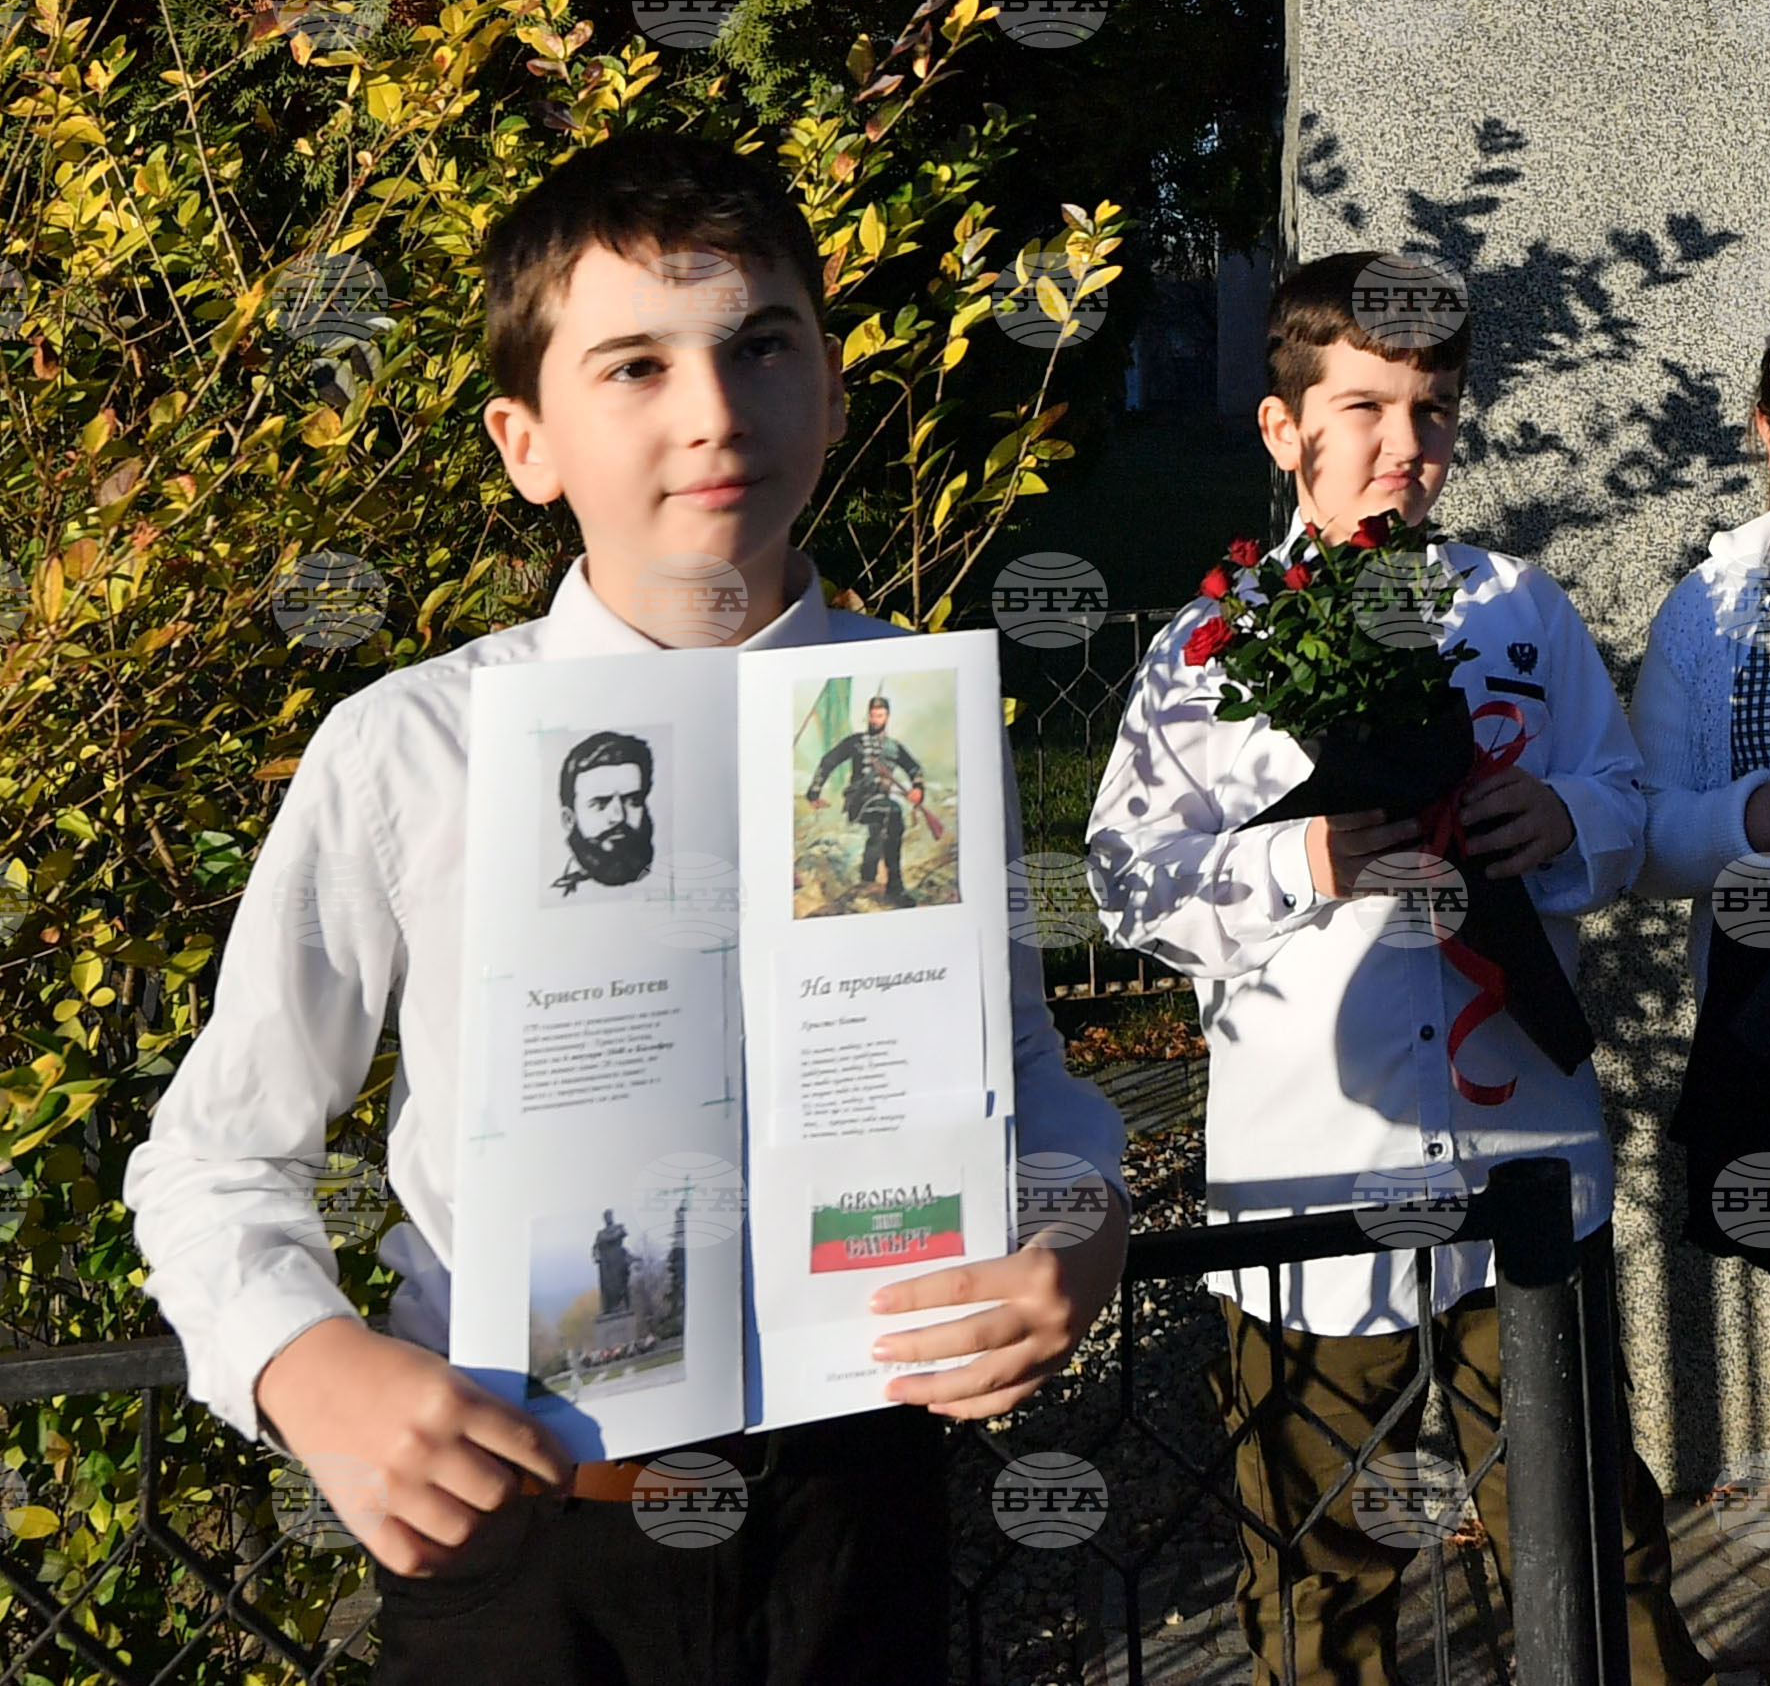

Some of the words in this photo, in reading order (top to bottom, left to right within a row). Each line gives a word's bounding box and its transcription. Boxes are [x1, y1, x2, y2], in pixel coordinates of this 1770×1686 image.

[526, 986, 604, 1010] Христо
[610, 978, 669, 998] Ботев
[800, 975, 832, 998] На
[838, 967, 948, 999] прощаване
[839, 1183, 937, 1212] СВОБОДА
